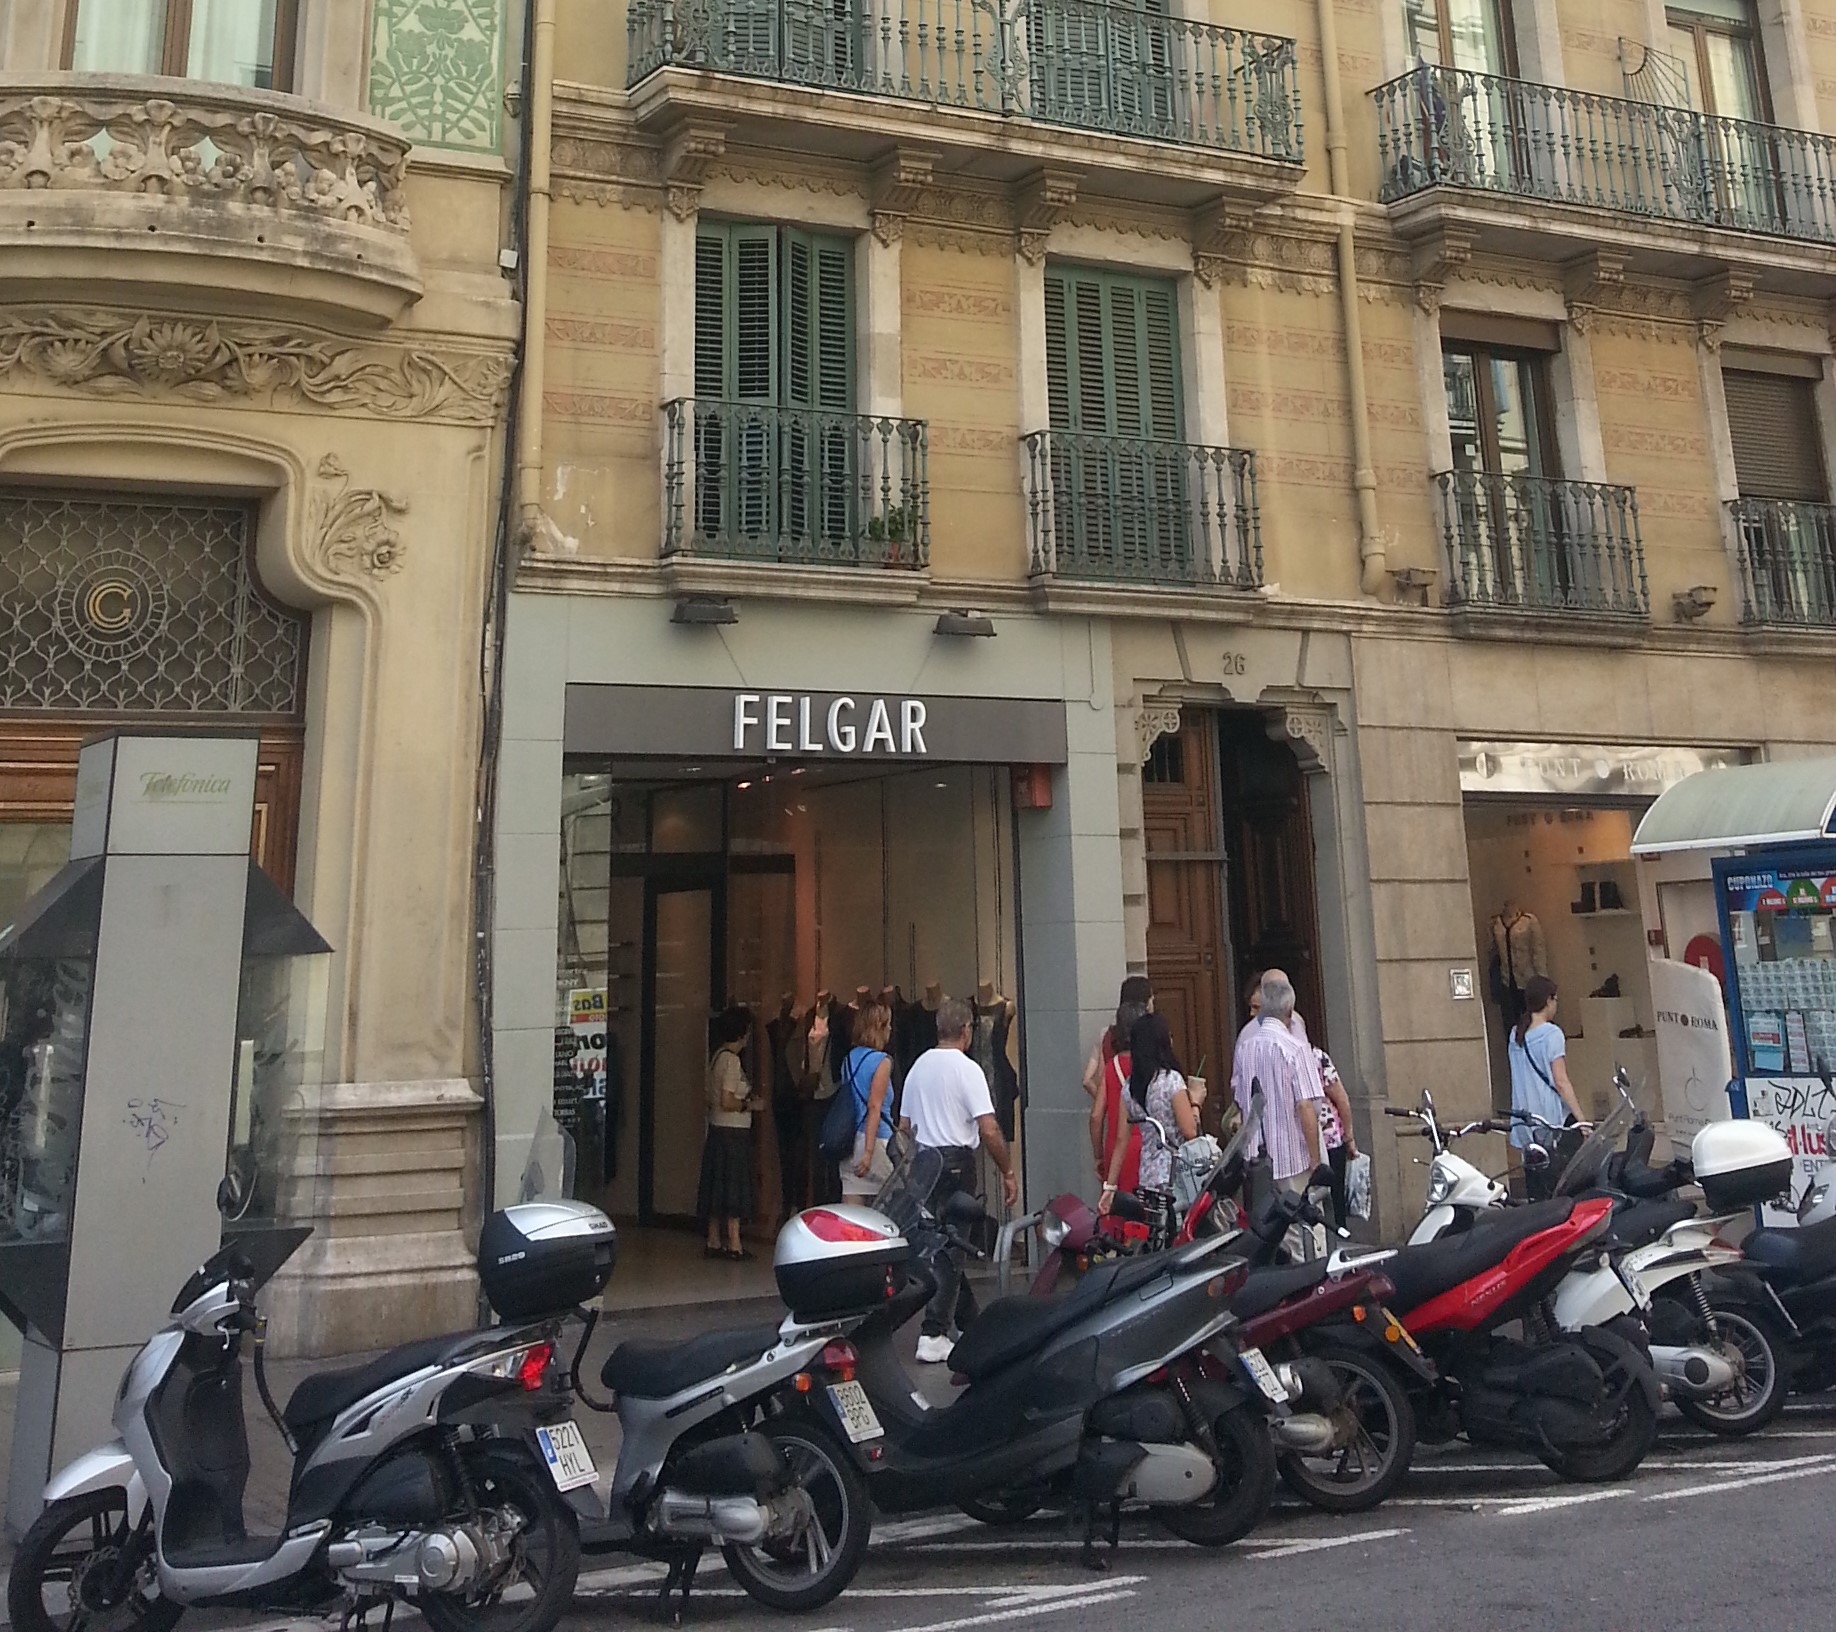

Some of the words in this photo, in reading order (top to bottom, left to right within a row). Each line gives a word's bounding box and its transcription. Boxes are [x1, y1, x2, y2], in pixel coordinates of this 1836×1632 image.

[1222, 651, 1246, 676] 26
[733, 694, 928, 754] FELGAR
[139, 771, 232, 797] Telefónica
[1657, 1011, 1679, 1024] PUNT
[1691, 1016, 1719, 1031] ROMA
[548, 1425, 580, 1450] 5221
[559, 1452, 586, 1477] HYL
